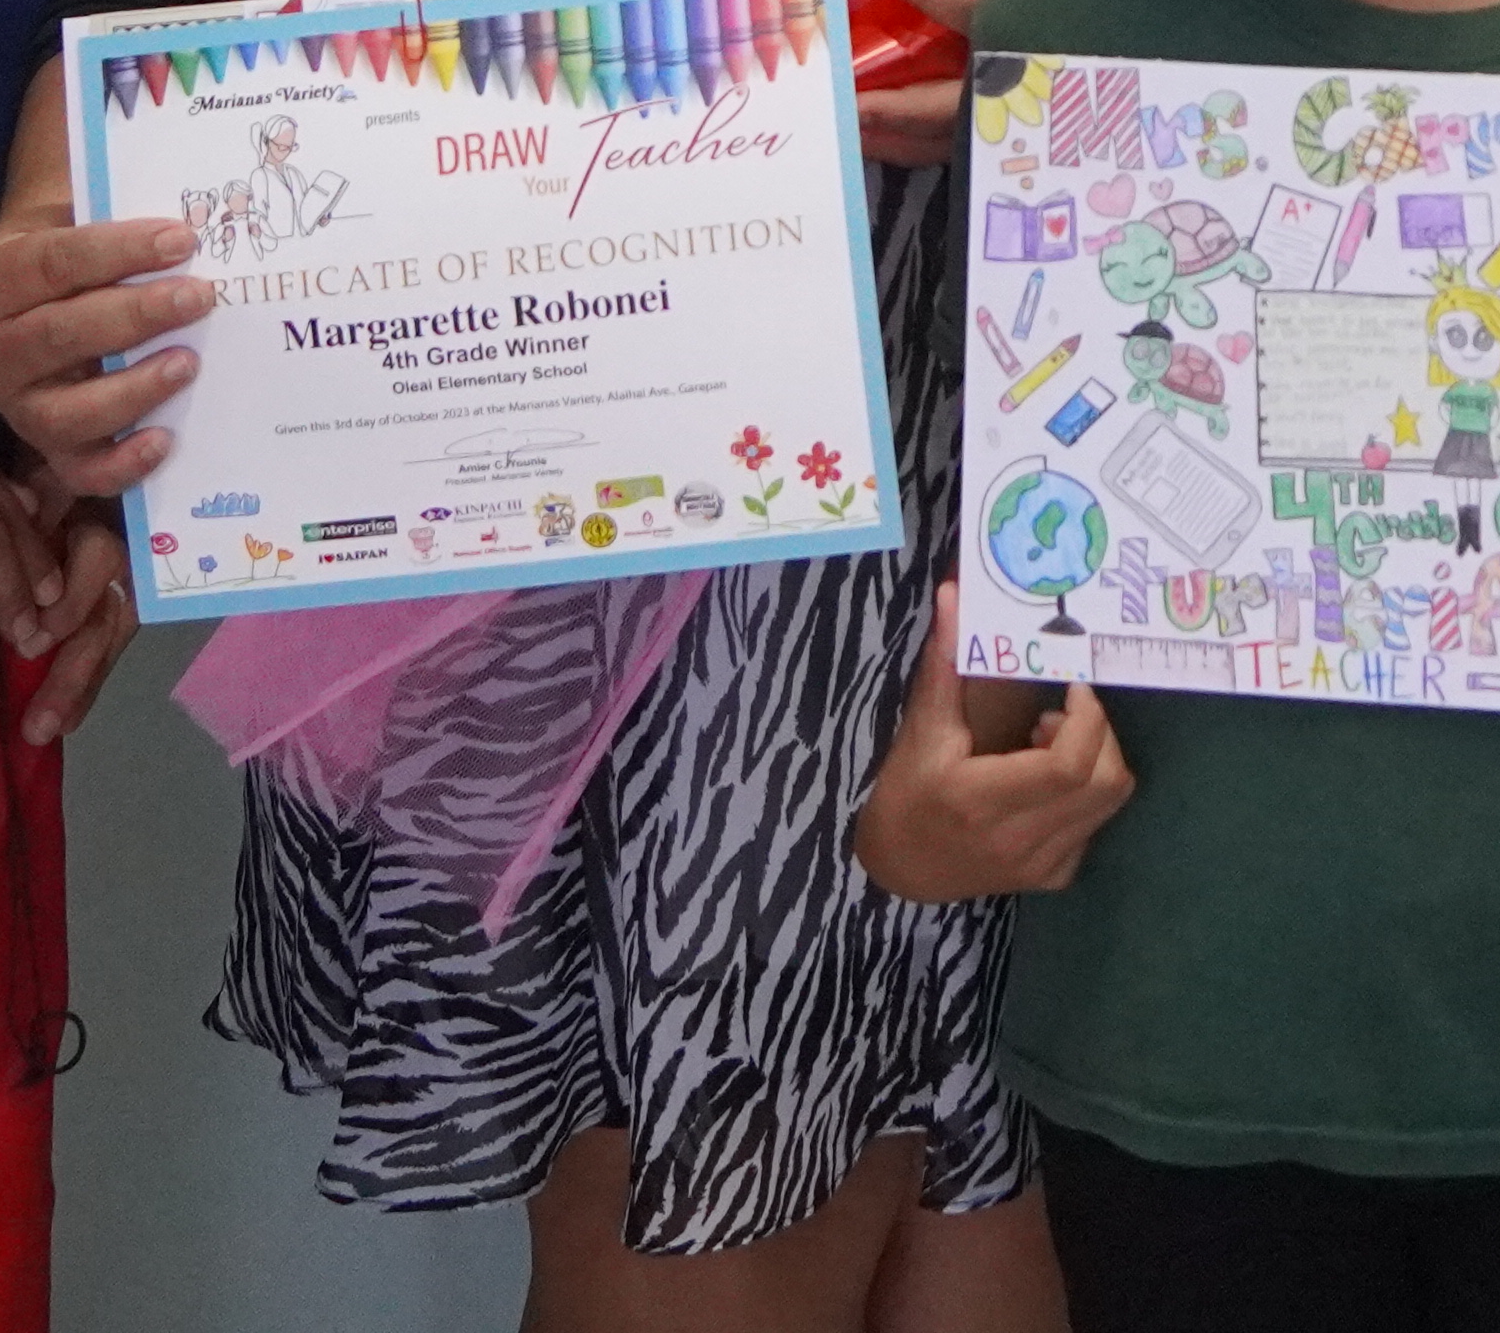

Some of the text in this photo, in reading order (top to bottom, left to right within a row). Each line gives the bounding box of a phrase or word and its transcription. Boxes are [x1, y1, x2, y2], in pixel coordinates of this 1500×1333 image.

[188, 92, 272, 116] Marianas
[275, 84, 346, 103] Variety
[365, 108, 421, 130] presents
[1049, 67, 1269, 180] Mrs.
[436, 82, 793, 220] DRAW Teacher
[523, 174, 571, 198] Your
[211, 214, 804, 308] RTIFICATE OF RECOGNITION
[283, 279, 671, 352] Margarette Robonei
[382, 334, 590, 371] 4th Grade Winner
[392, 362, 588, 395] Oleai Elementary School
[275, 423, 308, 435] Given
[310, 421, 331, 432] this
[335, 418, 353, 430] 3rd
[355, 417, 376, 431] day
[378, 416, 391, 426] of
[392, 411, 440, 425] October
[442, 408, 471, 420] 2023
[473, 406, 484, 416] at
[487, 403, 506, 414] the
[508, 399, 561, 412] Marianas
[1271, 469, 1385, 547] 4TH
[336, 548, 389, 563] SAIPAN
[1336, 498, 1457, 580] Grade
[1236, 639, 1448, 703] TEACHER
